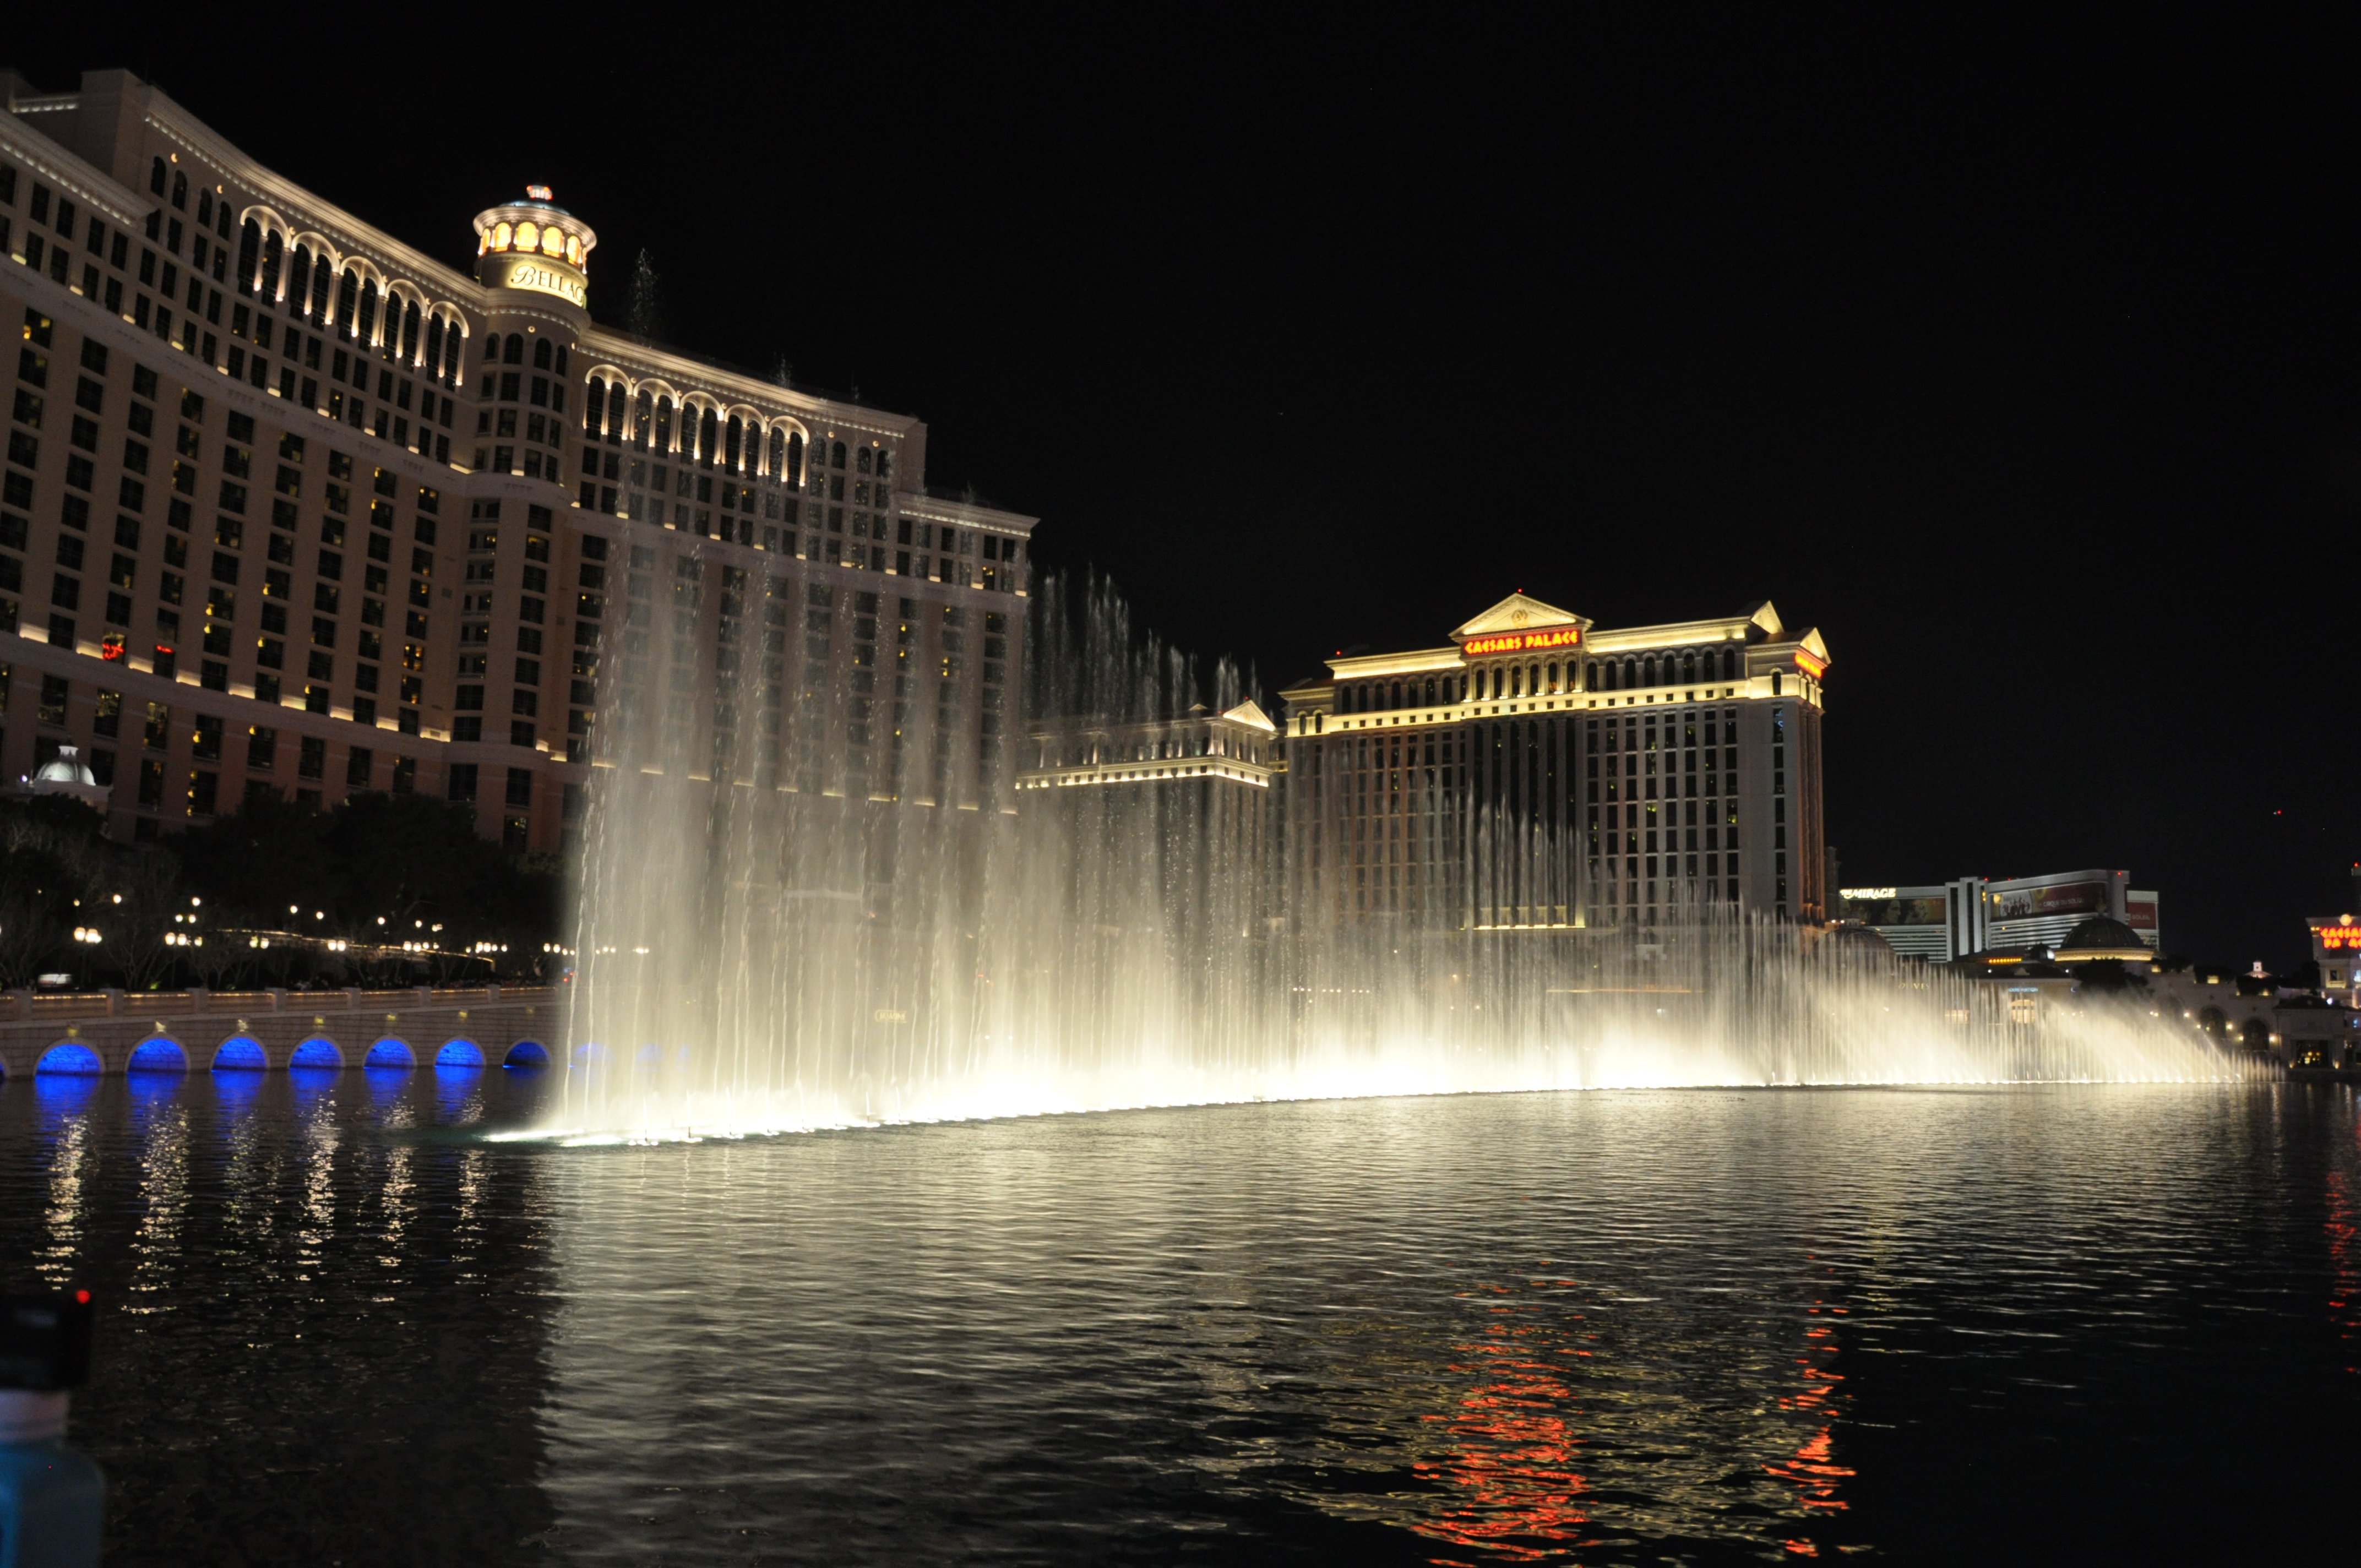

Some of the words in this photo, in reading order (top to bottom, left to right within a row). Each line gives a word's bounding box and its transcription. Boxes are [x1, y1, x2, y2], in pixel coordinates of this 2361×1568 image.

[1465, 636, 1522, 655] CAESARS
[1525, 630, 1578, 648] PALACE
[1852, 888, 1896, 899] MIRAGE
